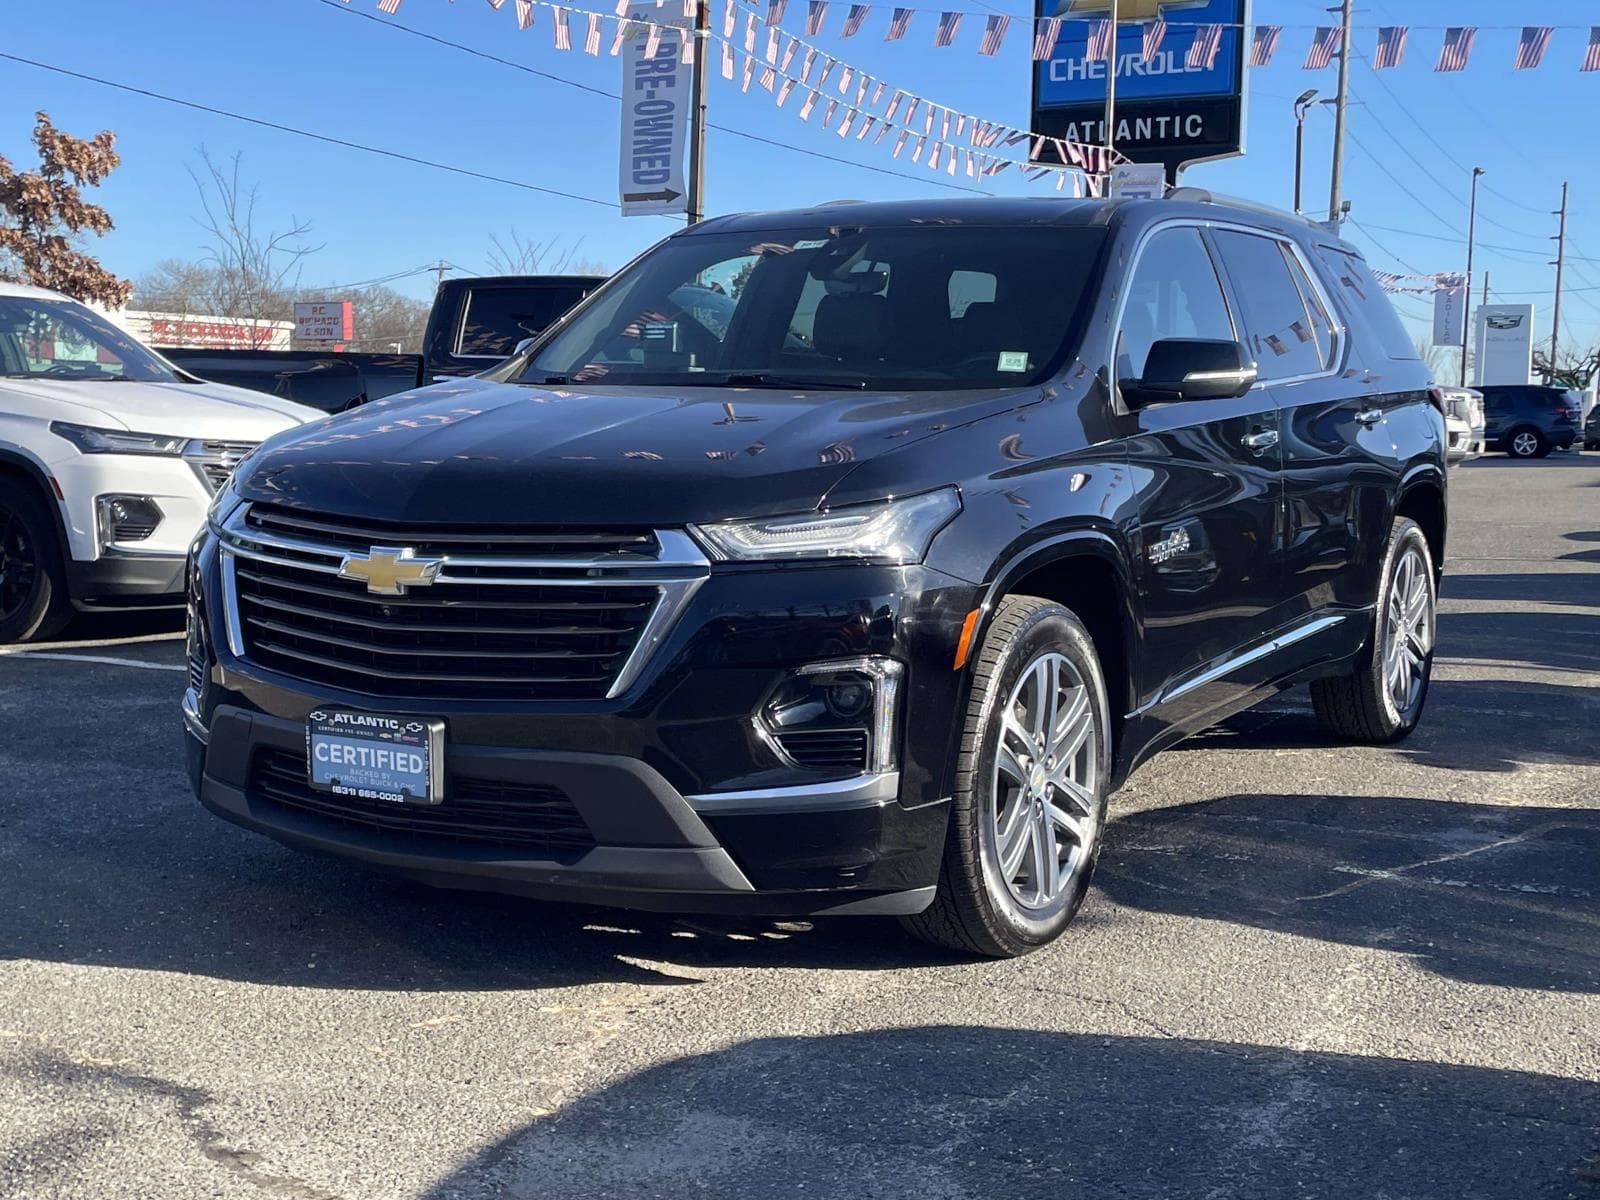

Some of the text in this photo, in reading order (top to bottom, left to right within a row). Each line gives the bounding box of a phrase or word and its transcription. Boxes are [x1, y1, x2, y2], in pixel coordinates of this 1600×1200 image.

[633, 42, 677, 185] PRE-OWNED
[1066, 115, 1203, 142] ATLANTIC
[314, 327, 333, 336] SON
[334, 713, 399, 730] ATLANTIC
[315, 743, 423, 774] CERTIFIED
[350, 768, 382, 779] BACKED
[371, 778, 393, 787] BUICK
[332, 786, 356, 796] (631)
